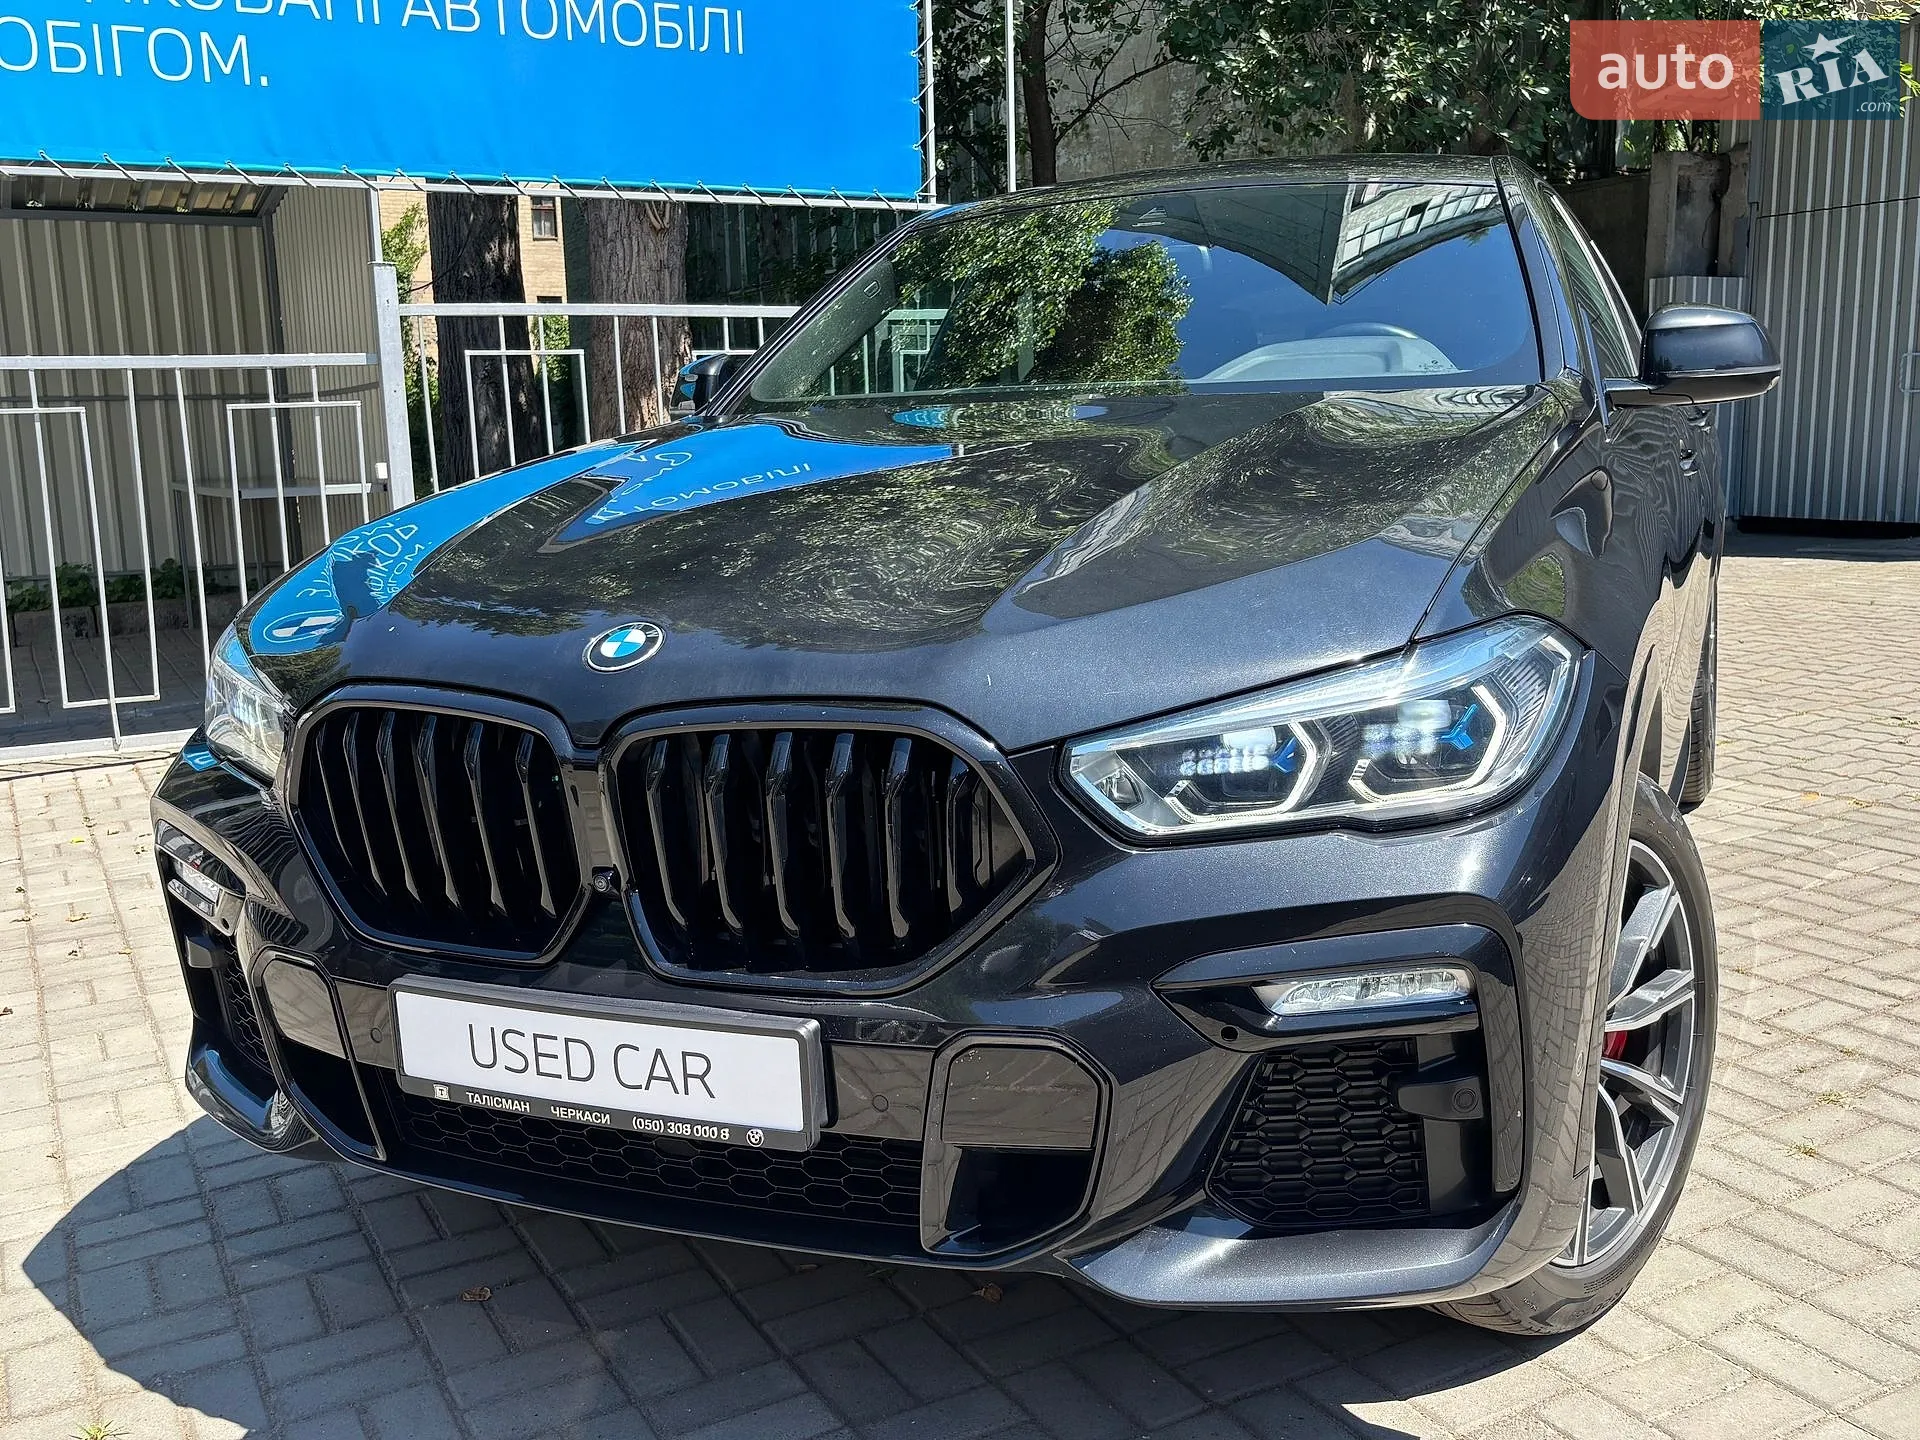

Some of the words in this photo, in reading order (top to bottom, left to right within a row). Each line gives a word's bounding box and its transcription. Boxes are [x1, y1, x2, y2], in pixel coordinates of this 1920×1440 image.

[468, 1023, 595, 1082] USED
[613, 1043, 716, 1099] CAR
[466, 1091, 530, 1113] ТАЛІСМАН
[550, 1105, 611, 1125] ЧЕРКАСИ
[632, 1116, 665, 1134] (050)
